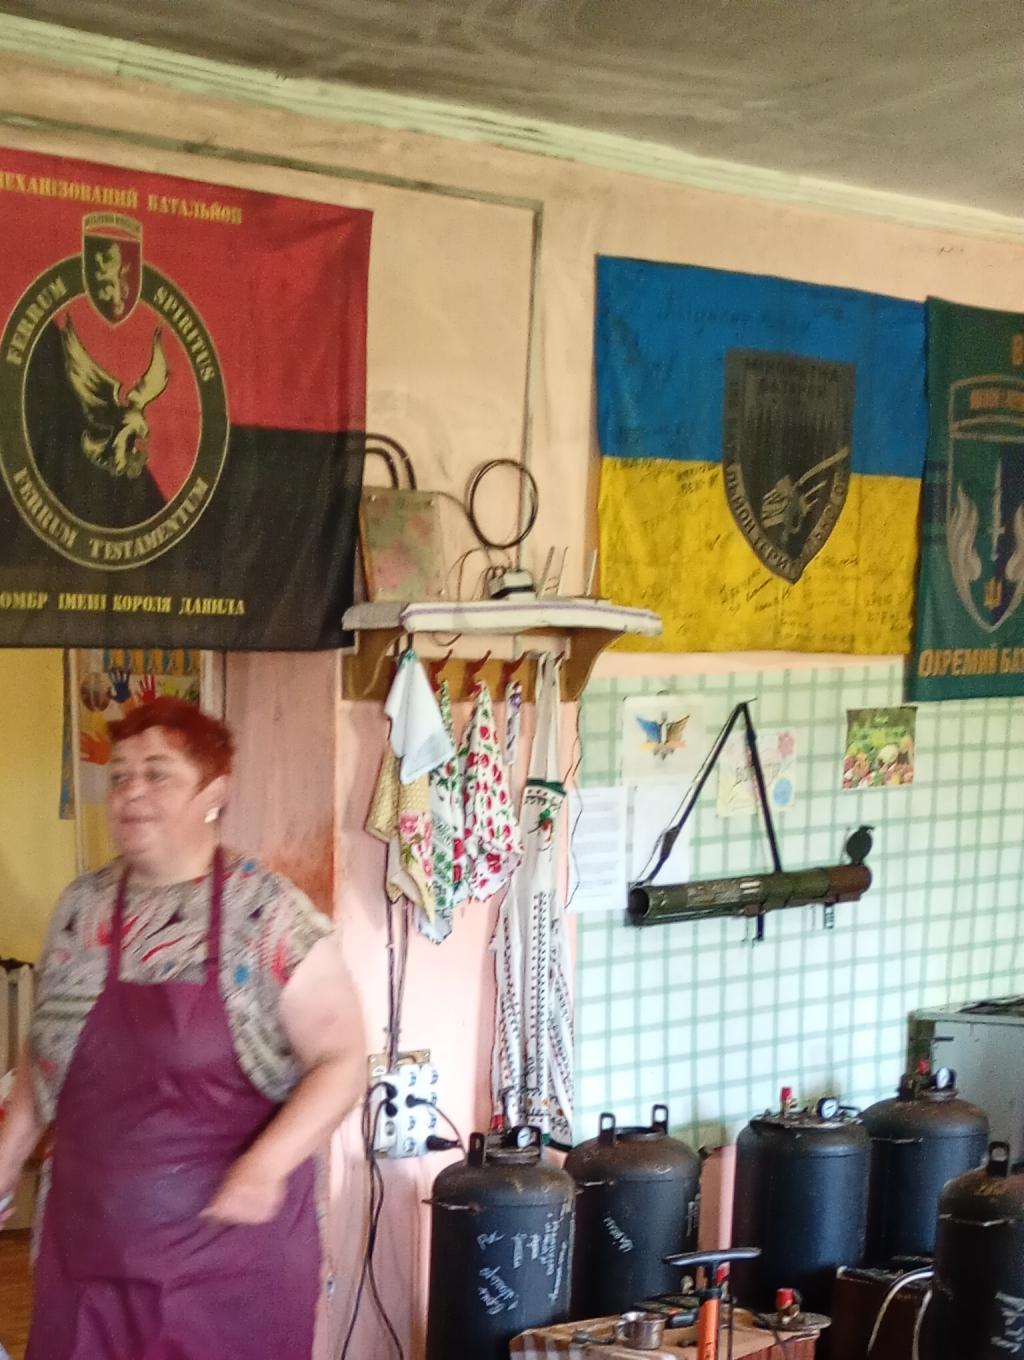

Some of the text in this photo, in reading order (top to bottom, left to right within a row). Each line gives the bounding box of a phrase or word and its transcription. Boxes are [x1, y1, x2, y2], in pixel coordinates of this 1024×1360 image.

[147, 194, 243, 225] БАТАЛЬЙОН
[6, 275, 215, 382] FERRUM SPIRITUS
[13, 467, 210, 561] FERRUM TESTAMENTUM
[0, 591, 49, 610] ОМБР
[58, 592, 107, 612] ІМЕНІ
[112, 594, 172, 614] КОРОЛЯ
[179, 595, 246, 616] ДАНИЛА
